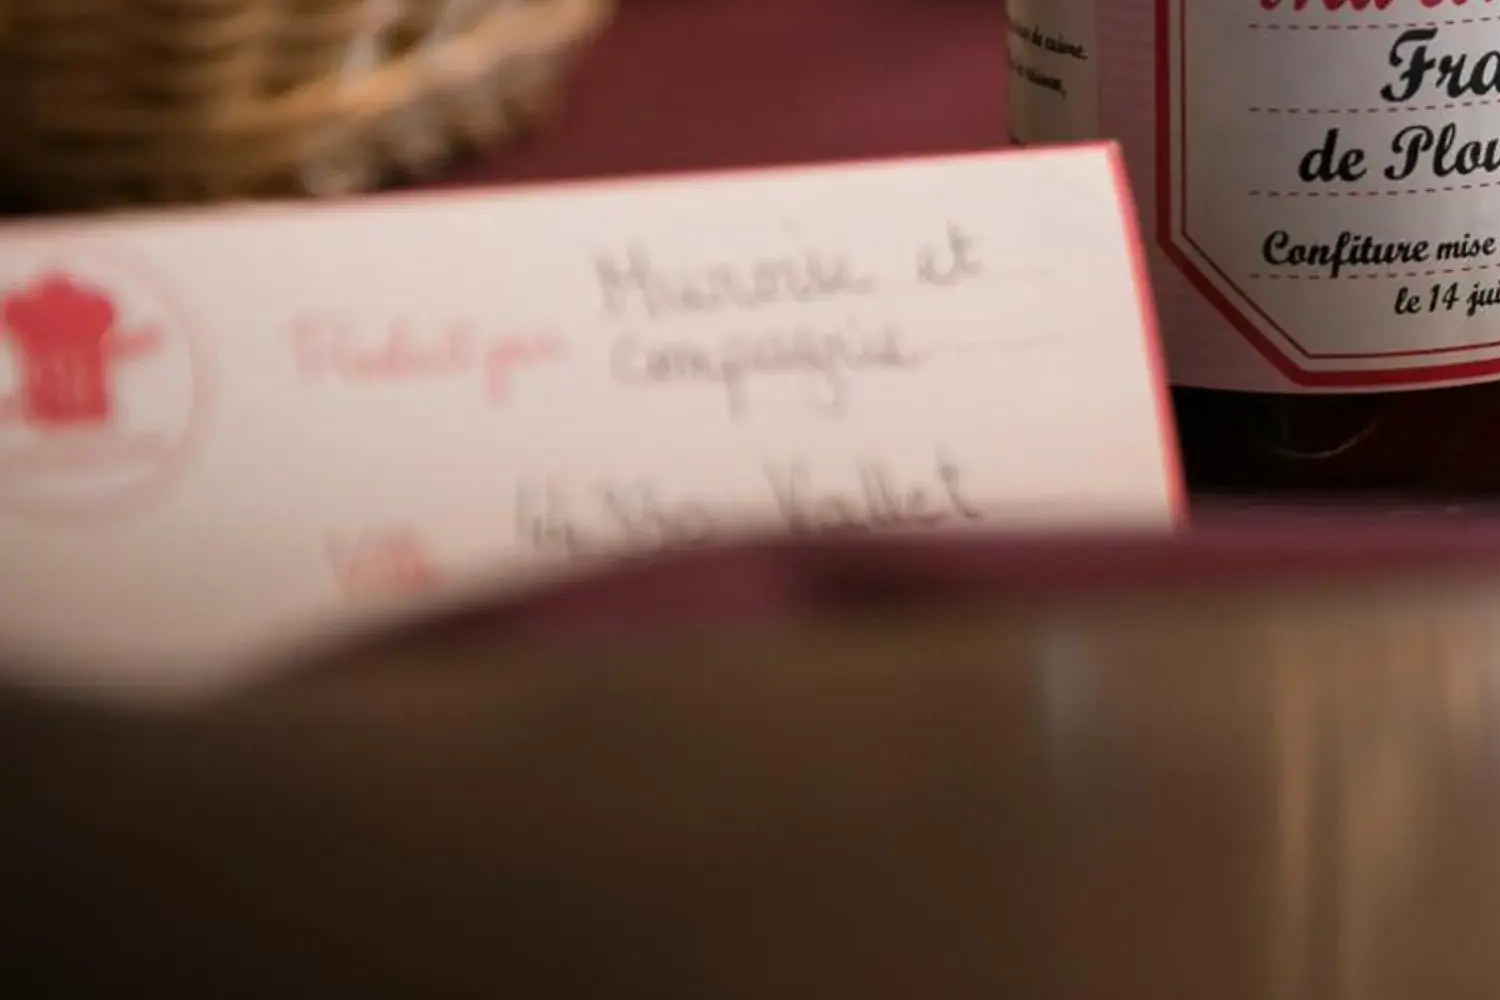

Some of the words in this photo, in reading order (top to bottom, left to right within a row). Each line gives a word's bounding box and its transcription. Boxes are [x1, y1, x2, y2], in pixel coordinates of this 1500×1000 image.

[1299, 128, 1367, 183] de
[915, 219, 983, 287] et
[1262, 229, 1429, 279] Confiture
[1436, 234, 1496, 263] mise
[1394, 286, 1421, 316] le
[1429, 284, 1459, 312] 14
